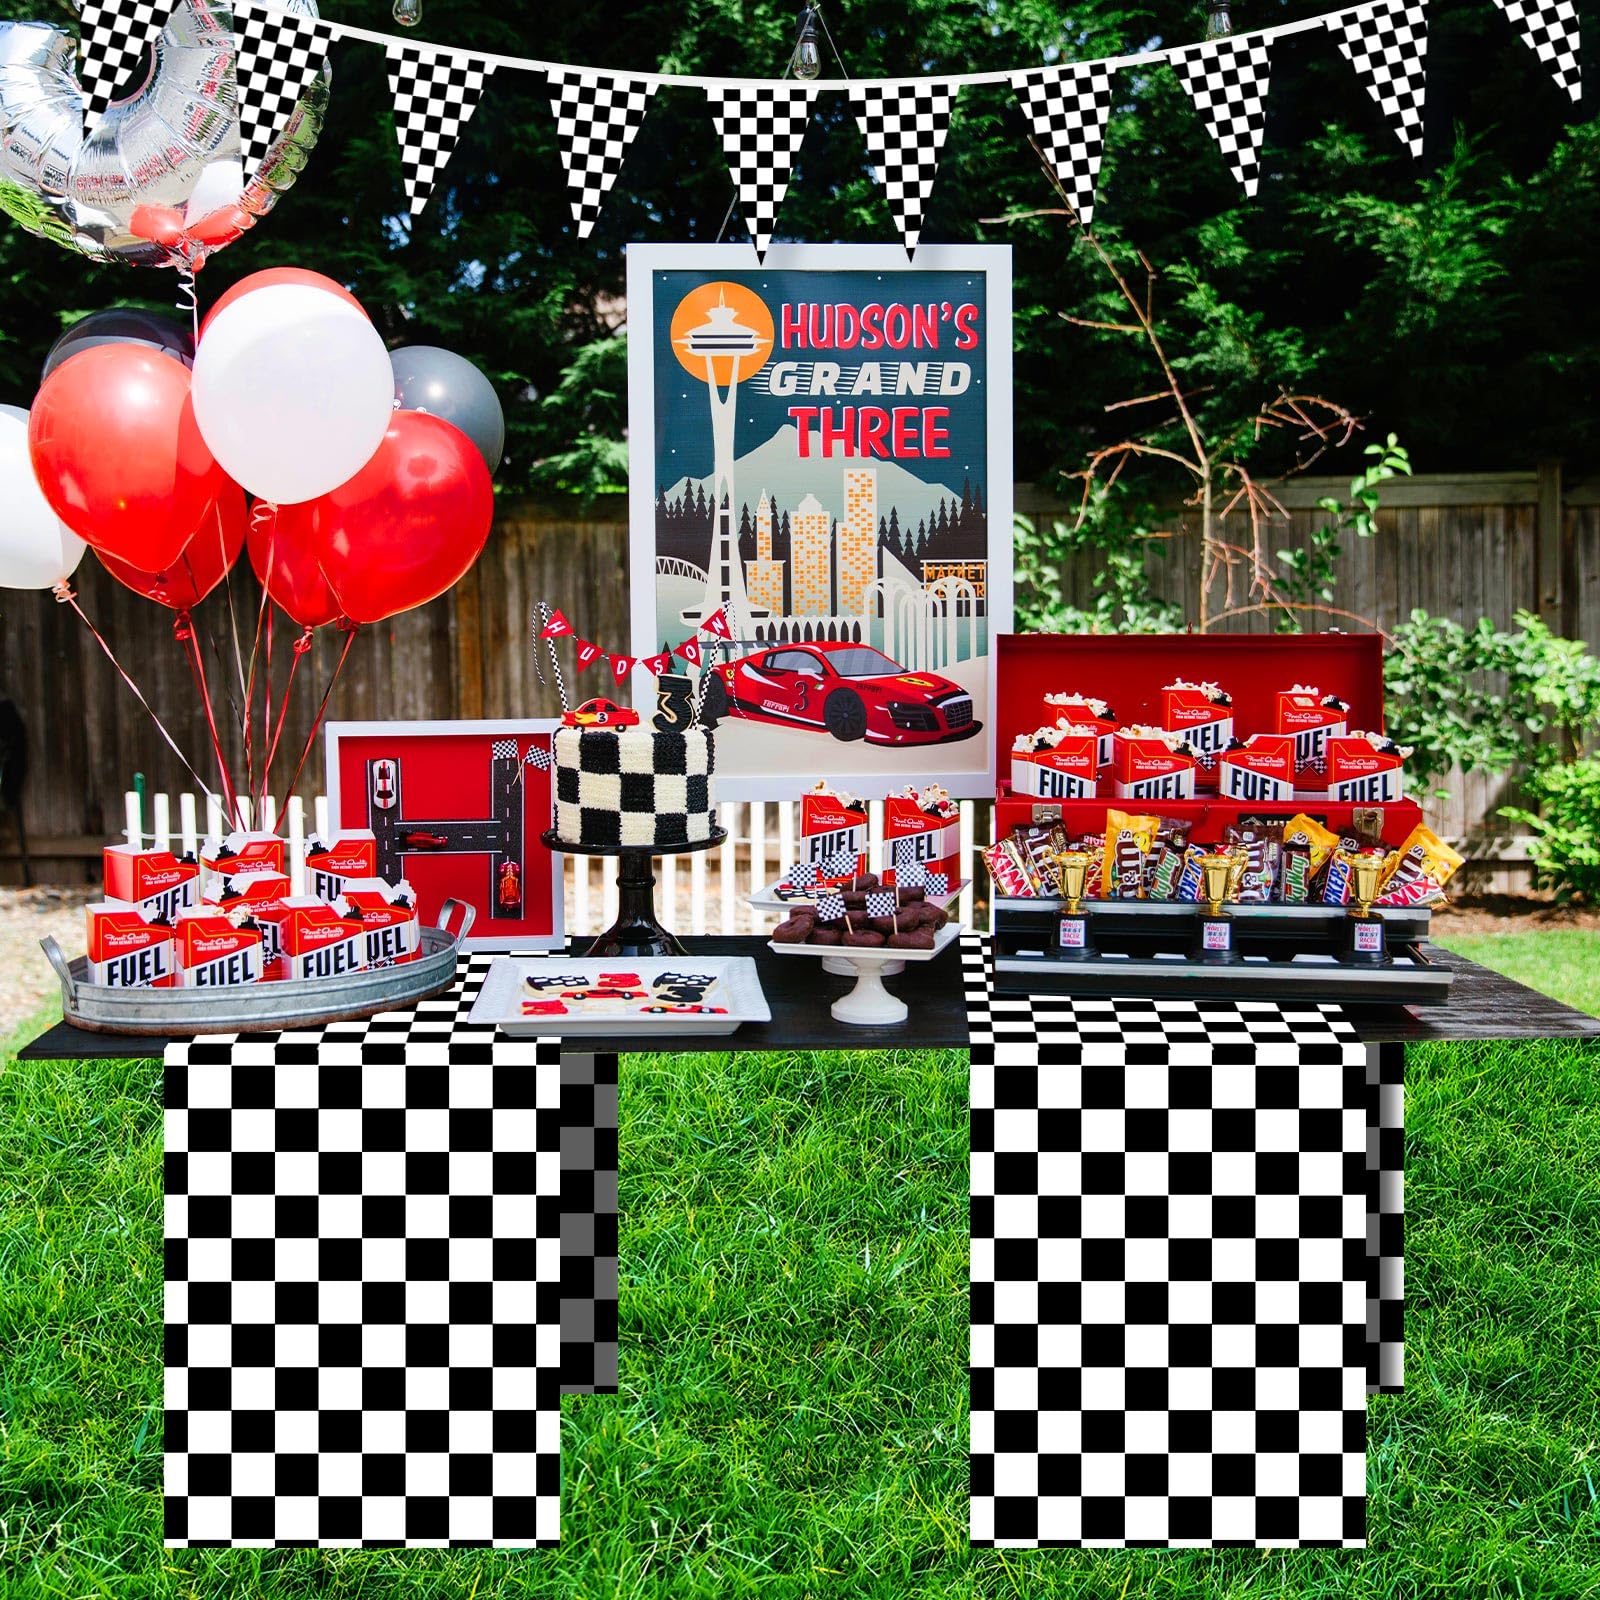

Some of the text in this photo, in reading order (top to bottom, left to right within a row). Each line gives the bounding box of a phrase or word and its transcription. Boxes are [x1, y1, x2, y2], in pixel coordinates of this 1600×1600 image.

[781, 302, 979, 350] HUDSON'S
[767, 361, 972, 397] GRAND
[787, 406, 951, 458] THREE
[925, 564, 985, 580] MARKET
[652, 673, 694, 733] 3
[794, 680, 809, 711] 3
[598, 711, 607, 723] 3
[1185, 724, 1223, 752] UEL
[810, 829, 858, 863] FUEL
[303, 940, 359, 978] FUEL
[366, 926, 407, 963] UEL
[107, 946, 166, 986] FUEL
[196, 951, 254, 986] FUEL
